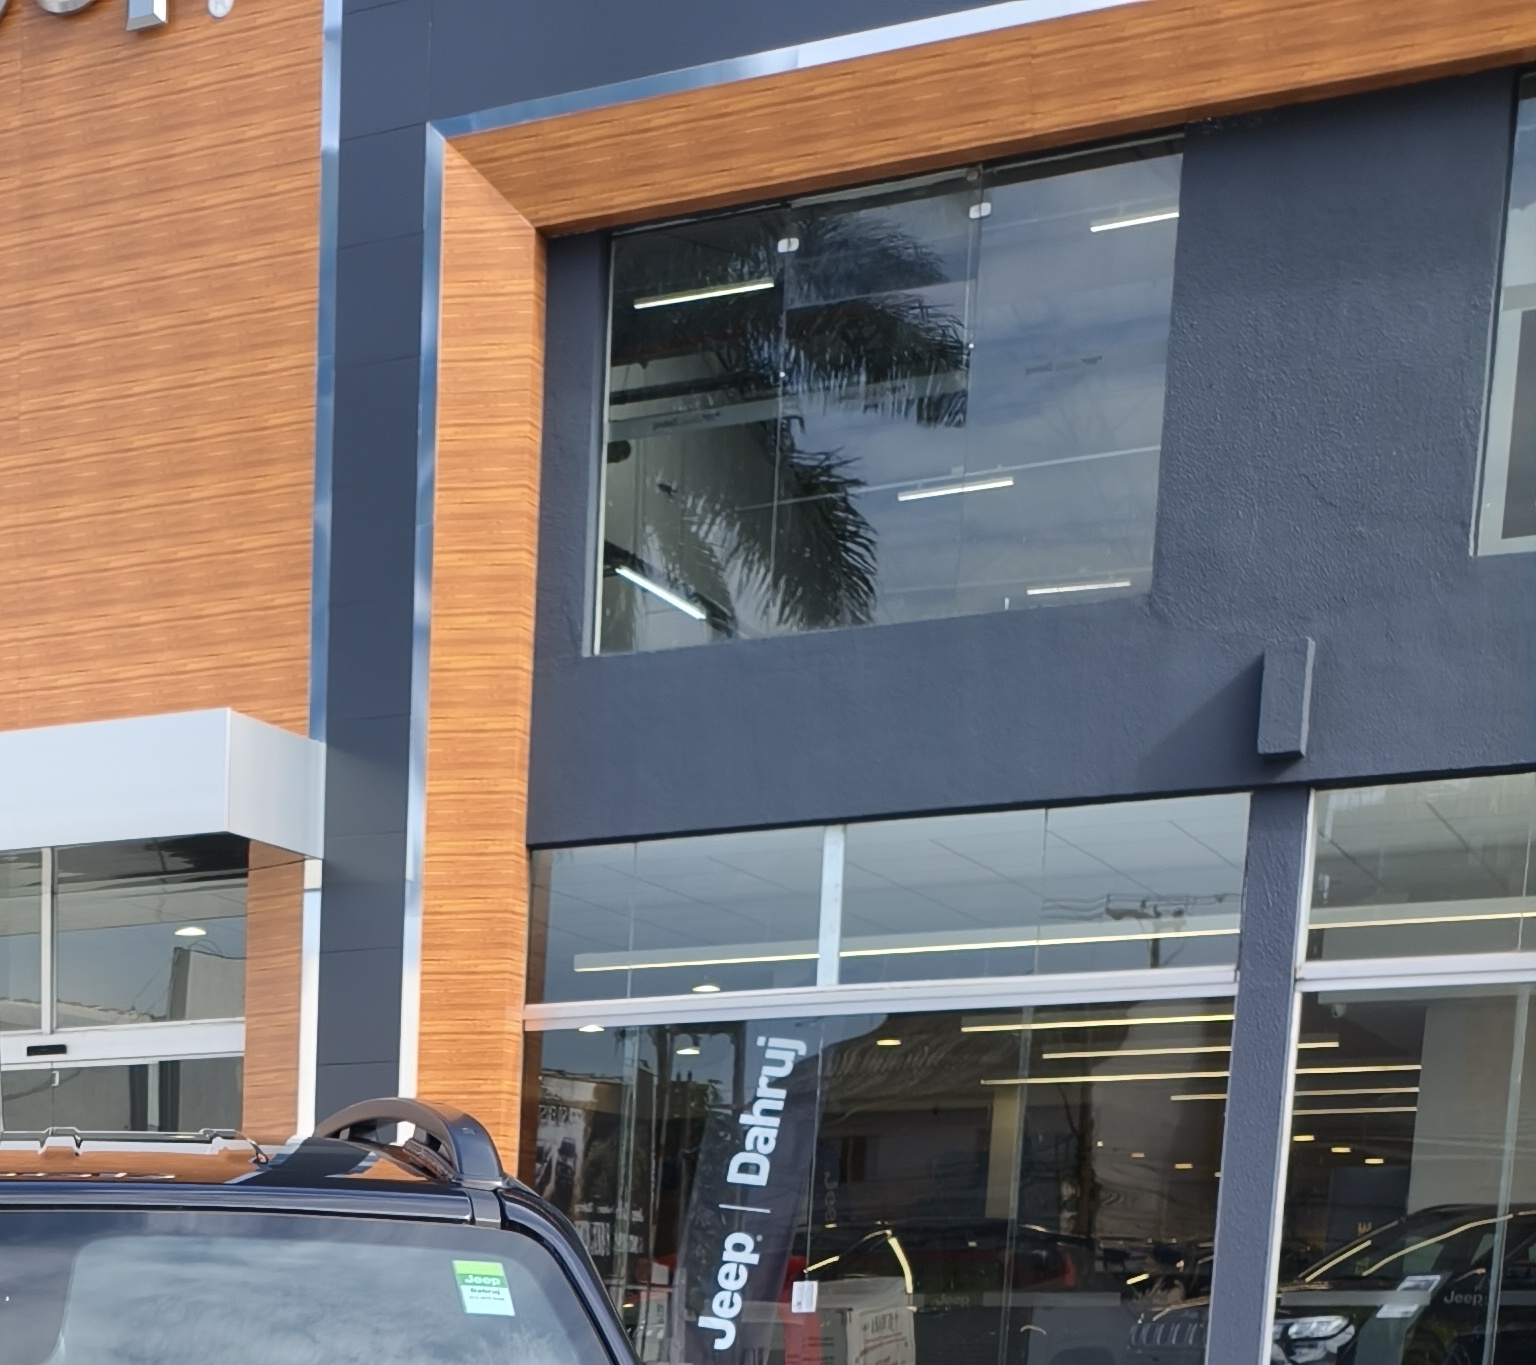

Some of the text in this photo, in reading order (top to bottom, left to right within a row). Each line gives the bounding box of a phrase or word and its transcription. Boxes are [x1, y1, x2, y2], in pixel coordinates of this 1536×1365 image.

[698, 1036, 807, 1351] Jeep Dahruj
[464, 1274, 501, 1287] Jeep
[1444, 1290, 1484, 1307] Jeep
